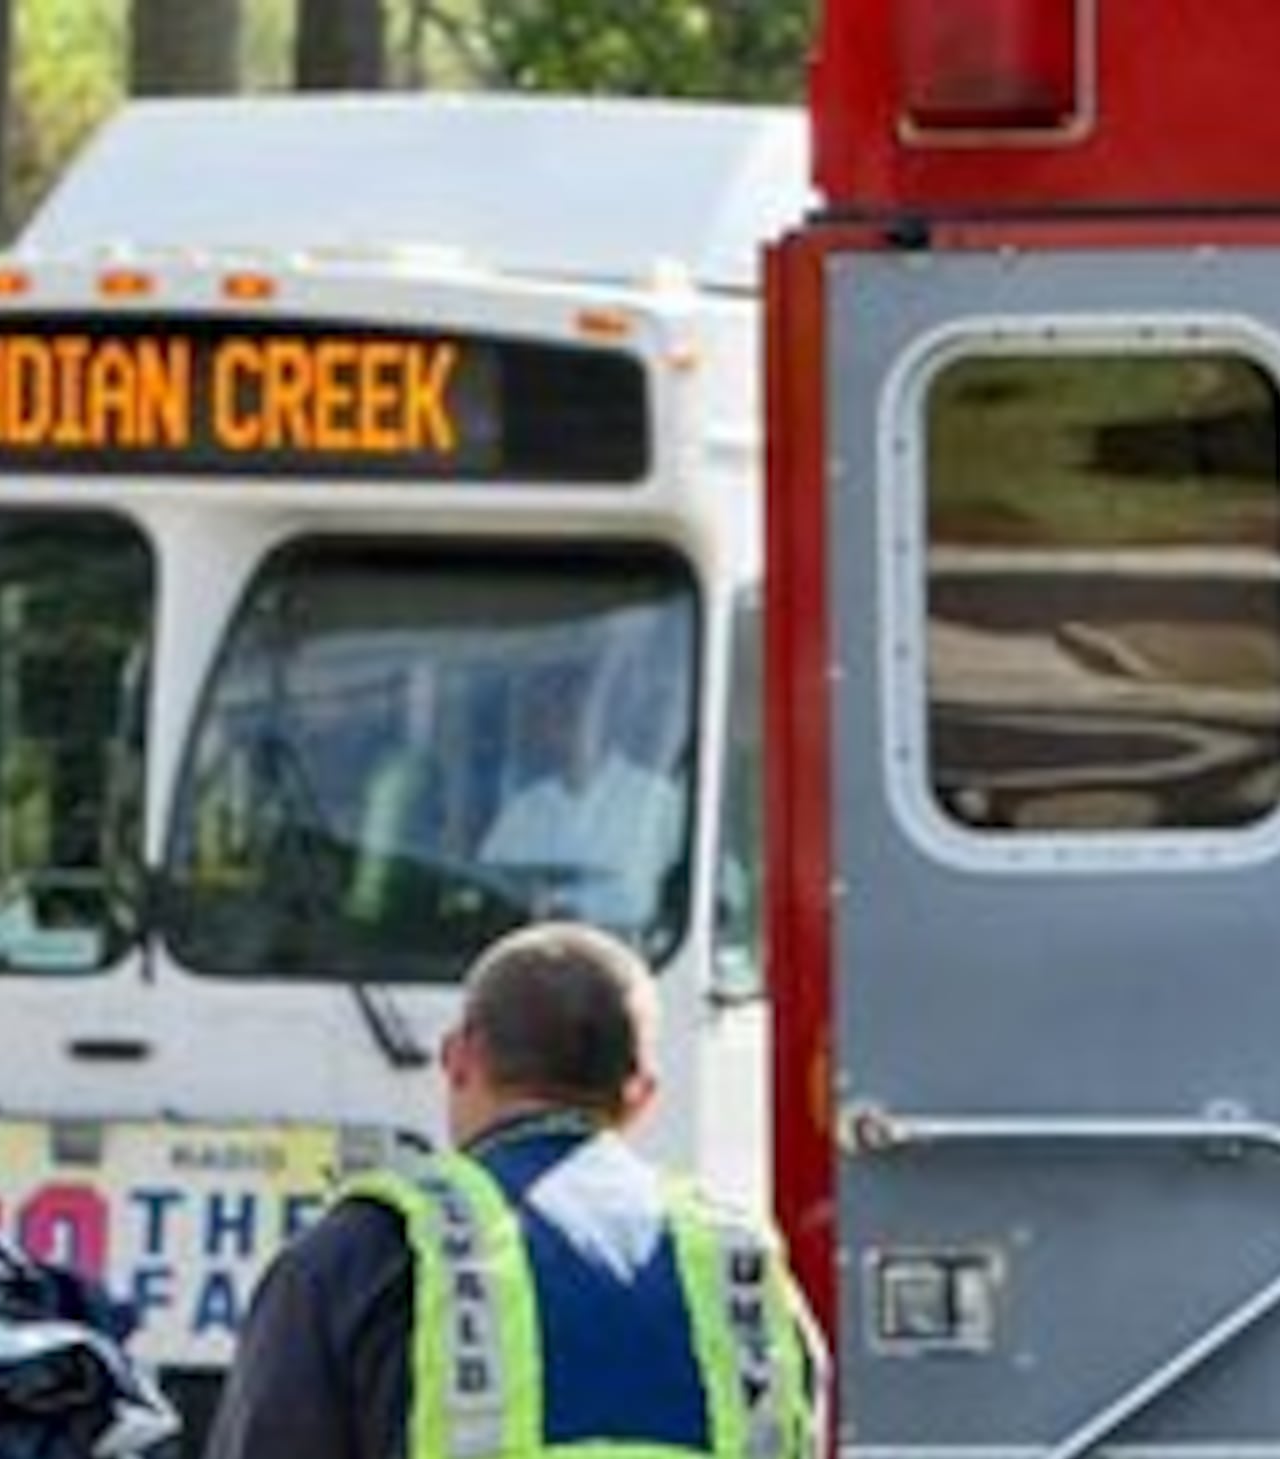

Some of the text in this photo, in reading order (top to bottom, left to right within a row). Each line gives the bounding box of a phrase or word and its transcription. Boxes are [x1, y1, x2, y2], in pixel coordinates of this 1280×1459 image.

[212, 339, 456, 452] CREEK
[130, 1190, 319, 1256] THE
[132, 1268, 245, 1337] FA
